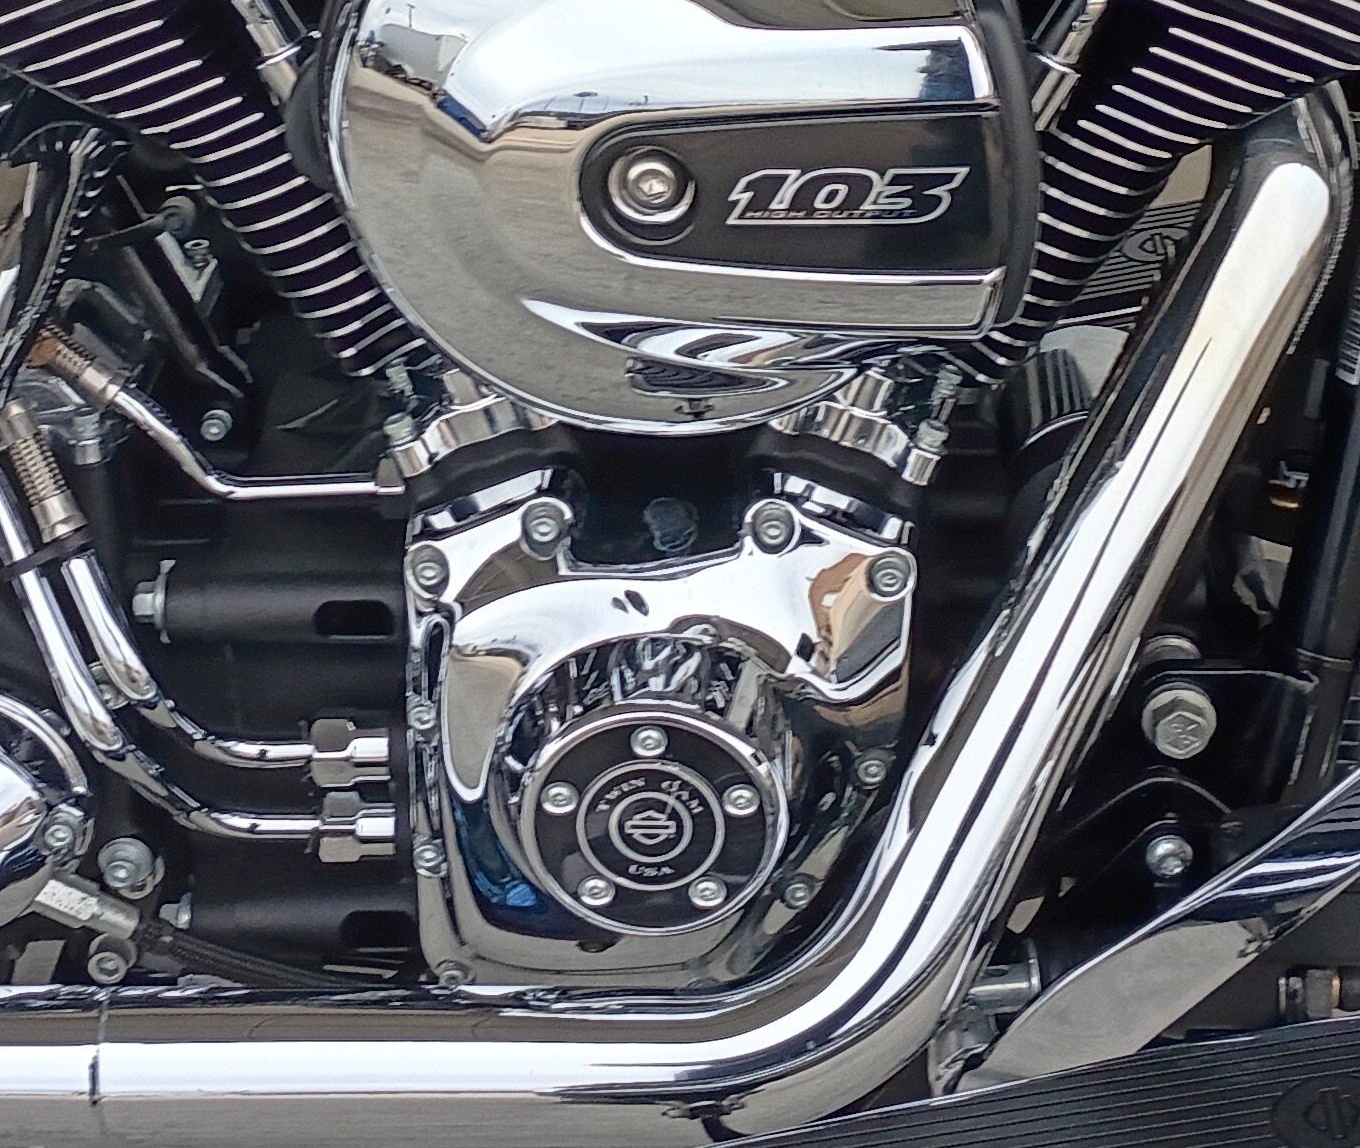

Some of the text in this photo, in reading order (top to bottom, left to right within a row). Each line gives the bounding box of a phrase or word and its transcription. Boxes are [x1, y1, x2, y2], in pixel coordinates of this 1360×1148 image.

[725, 166, 971, 227] 103
[744, 208, 918, 219] HIGH OUTPUT
